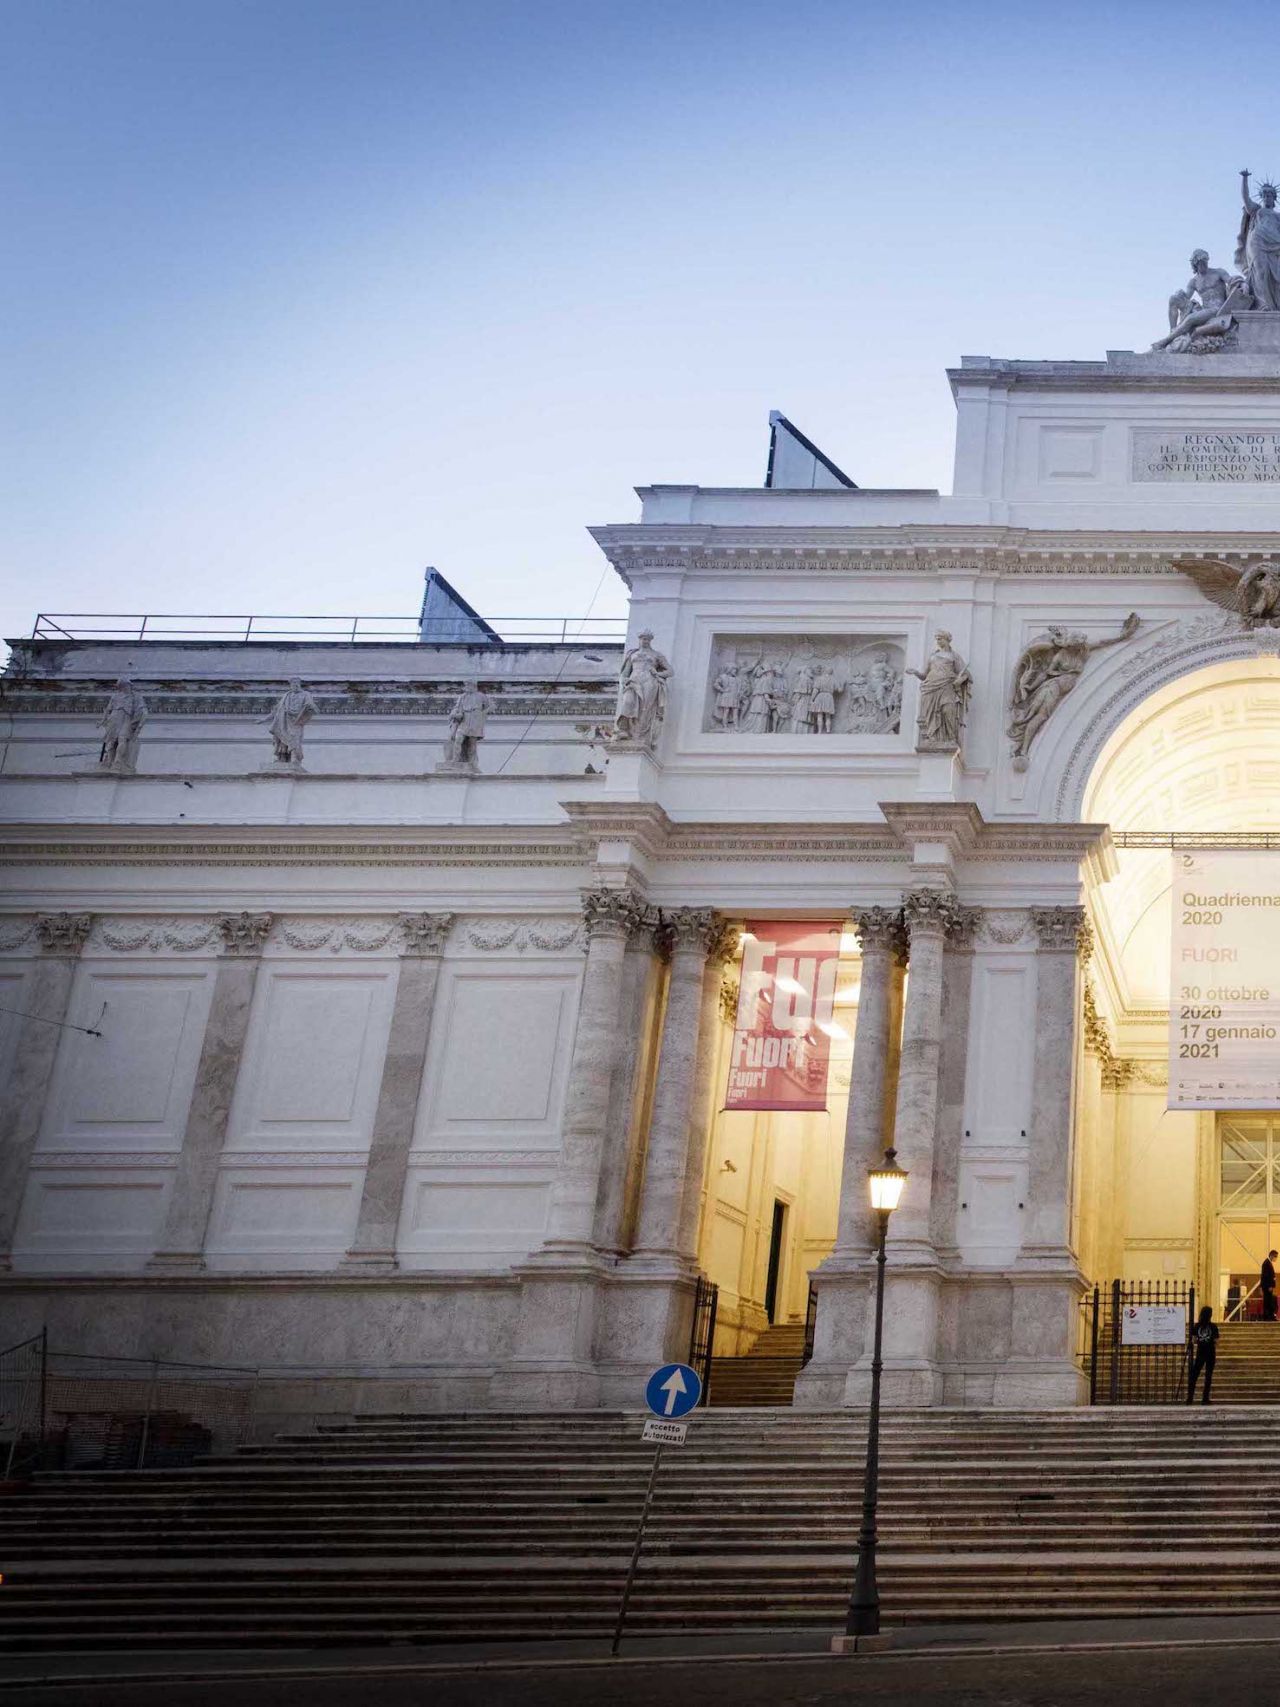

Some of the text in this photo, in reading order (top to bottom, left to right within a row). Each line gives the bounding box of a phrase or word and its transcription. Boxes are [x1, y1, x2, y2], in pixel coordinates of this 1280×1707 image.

[1185, 435, 1265, 445] REGNANDO
[1160, 445, 1173, 454] IL
[1182, 445, 1240, 454] COMUNE
[1250, 446, 1263, 454] DI
[1162, 454, 1179, 462] AD
[1186, 454, 1268, 463] ESPOSIZIONE
[1147, 463, 1248, 472] CONTRIBUENDO
[1182, 911, 1223, 926] 2020
[1182, 947, 1239, 962] FUORI
[1181, 984, 1270, 1001] 30 ottobre
[1180, 1004, 1222, 1019] 2020
[1180, 1023, 1276, 1043] 17 gennaio
[1179, 1043, 1219, 1058] 2021
